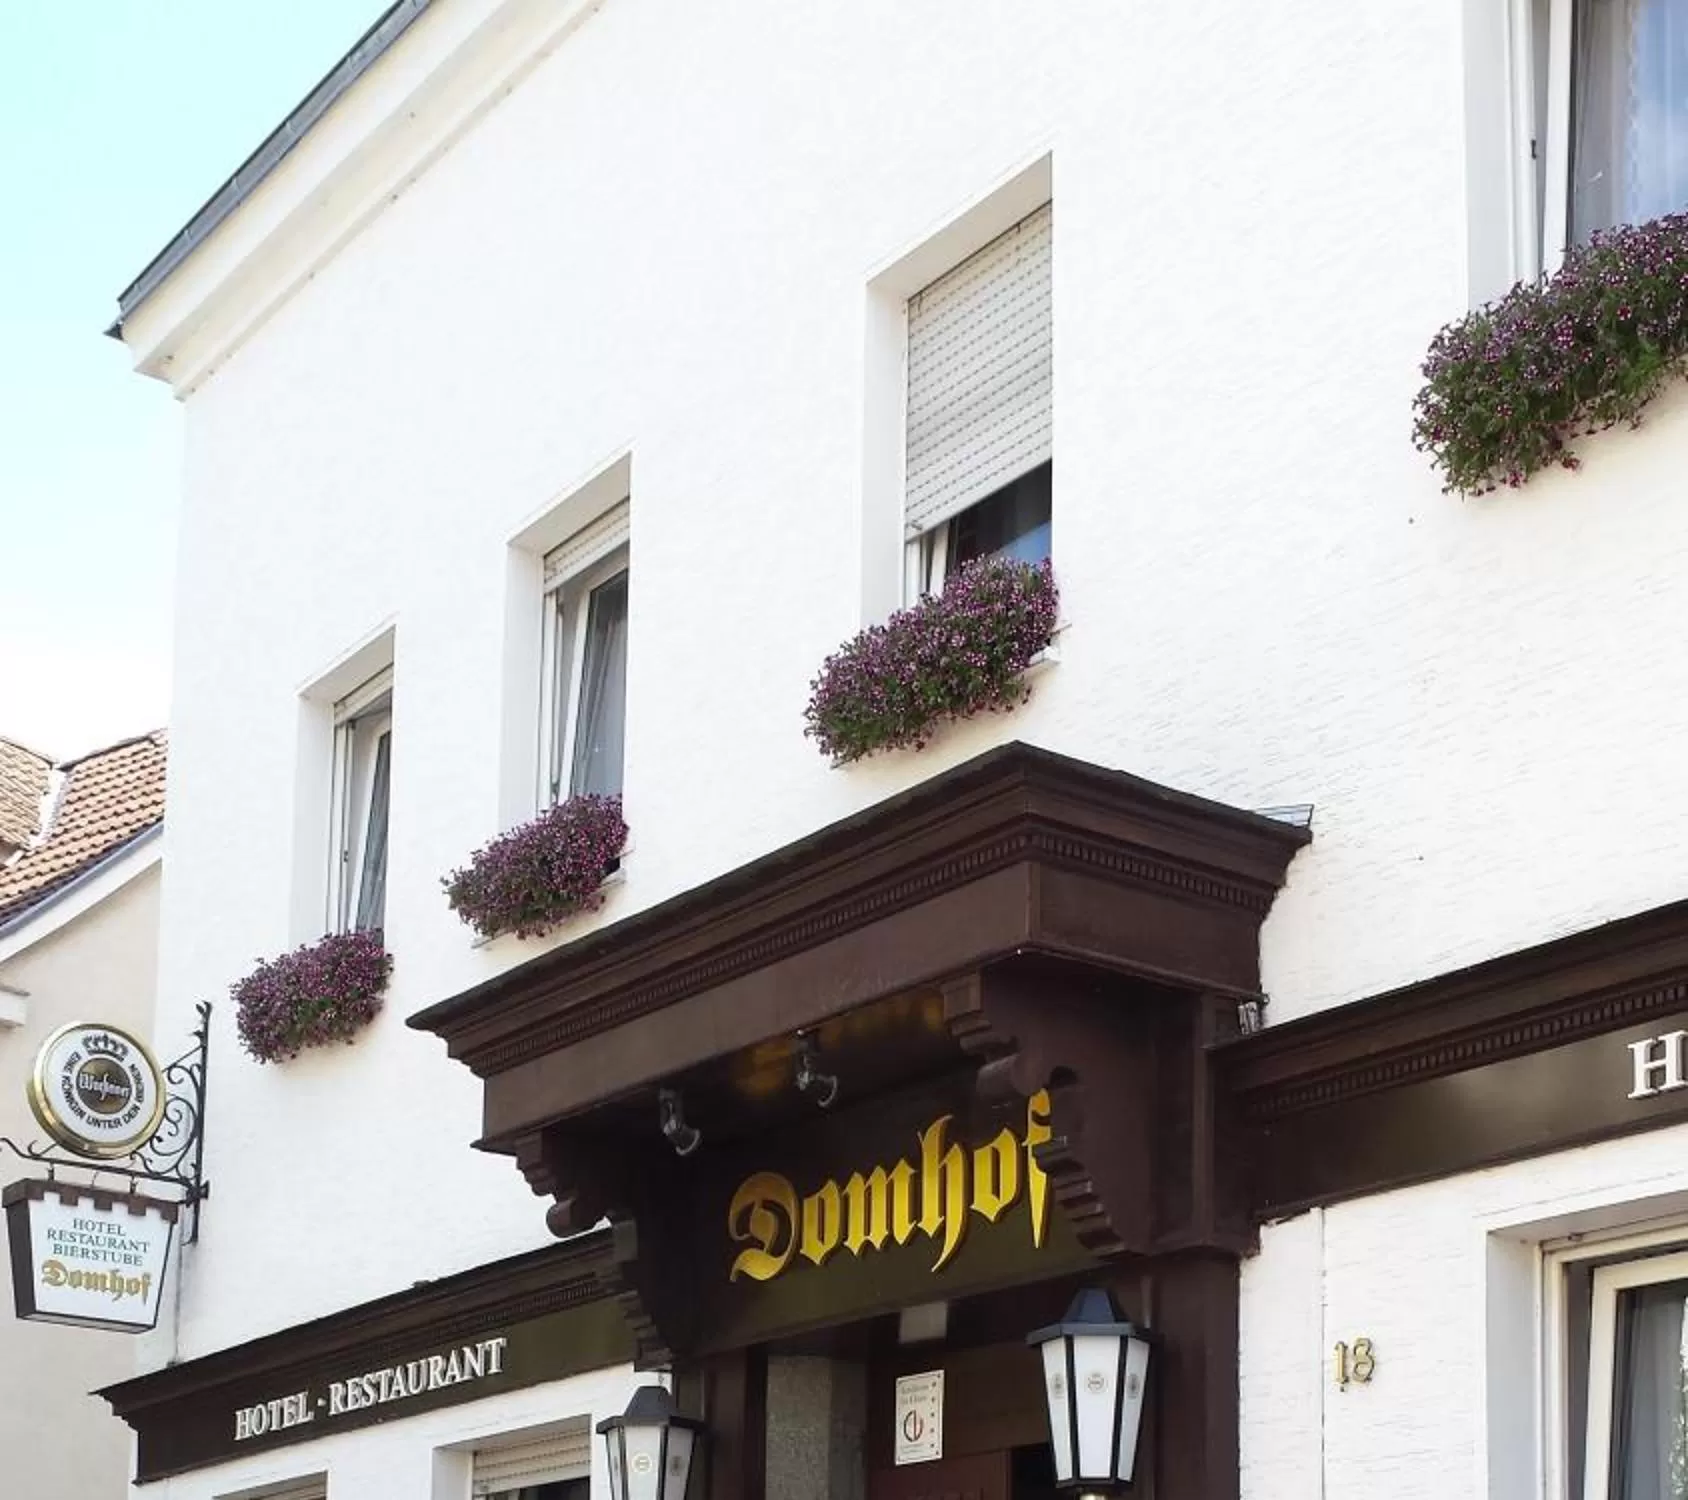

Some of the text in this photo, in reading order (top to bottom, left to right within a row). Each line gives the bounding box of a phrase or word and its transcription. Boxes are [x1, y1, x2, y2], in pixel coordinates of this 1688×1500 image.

[86, 1115, 123, 1130] UNTER
[121, 1103, 141, 1124] DEN
[729, 1088, 1051, 1283] Domhof
[47, 1227, 151, 1254] RESTAURANT
[72, 1218, 127, 1237] HOTEL
[52, 1243, 144, 1267] BIERSTUBE
[41, 1259, 152, 1306] Domhof
[233, 1337, 507, 1441] HOTEL RESTAURANT
